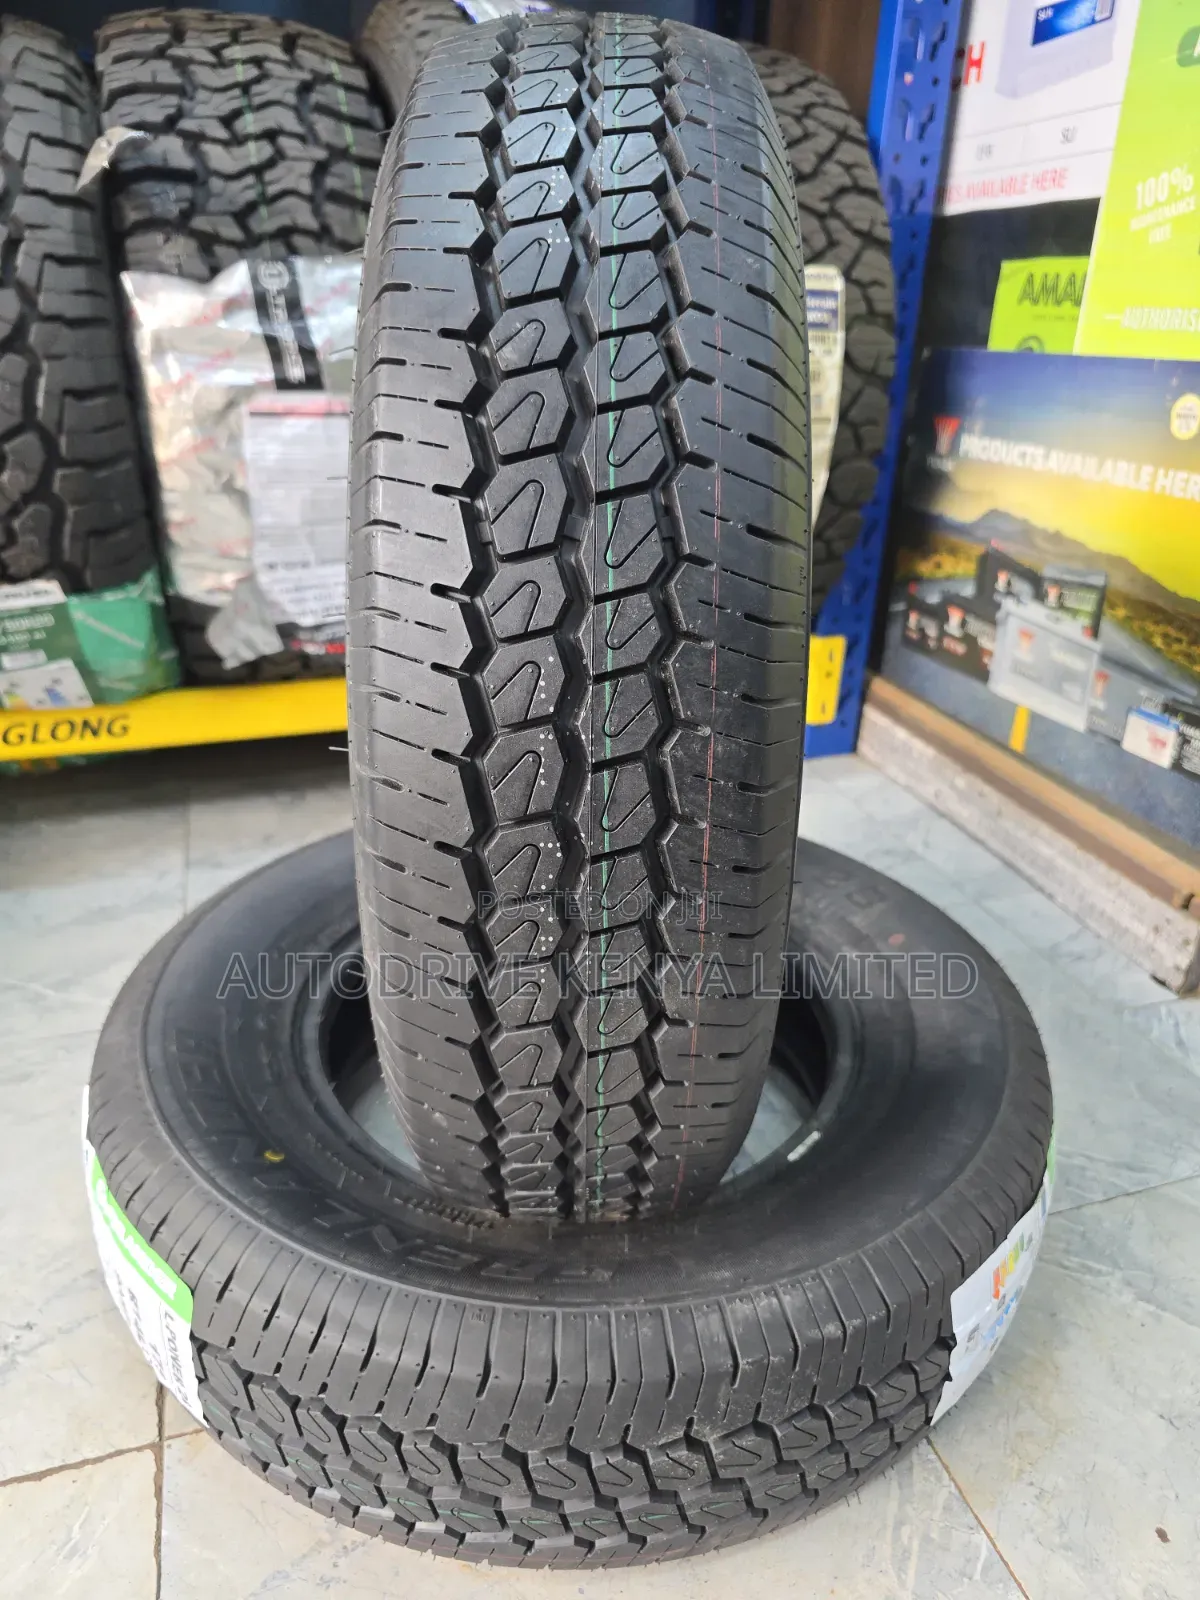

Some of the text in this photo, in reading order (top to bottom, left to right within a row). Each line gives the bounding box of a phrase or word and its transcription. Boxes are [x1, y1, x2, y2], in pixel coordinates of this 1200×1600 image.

[1031, 166, 1069, 192] HERE
[1135, 163, 1195, 211] 100%
[1120, 305, 1200, 333] AUTHORIS
[959, 432, 1045, 472] PRODUCTS
[1045, 448, 1155, 491] AVAILABLE
